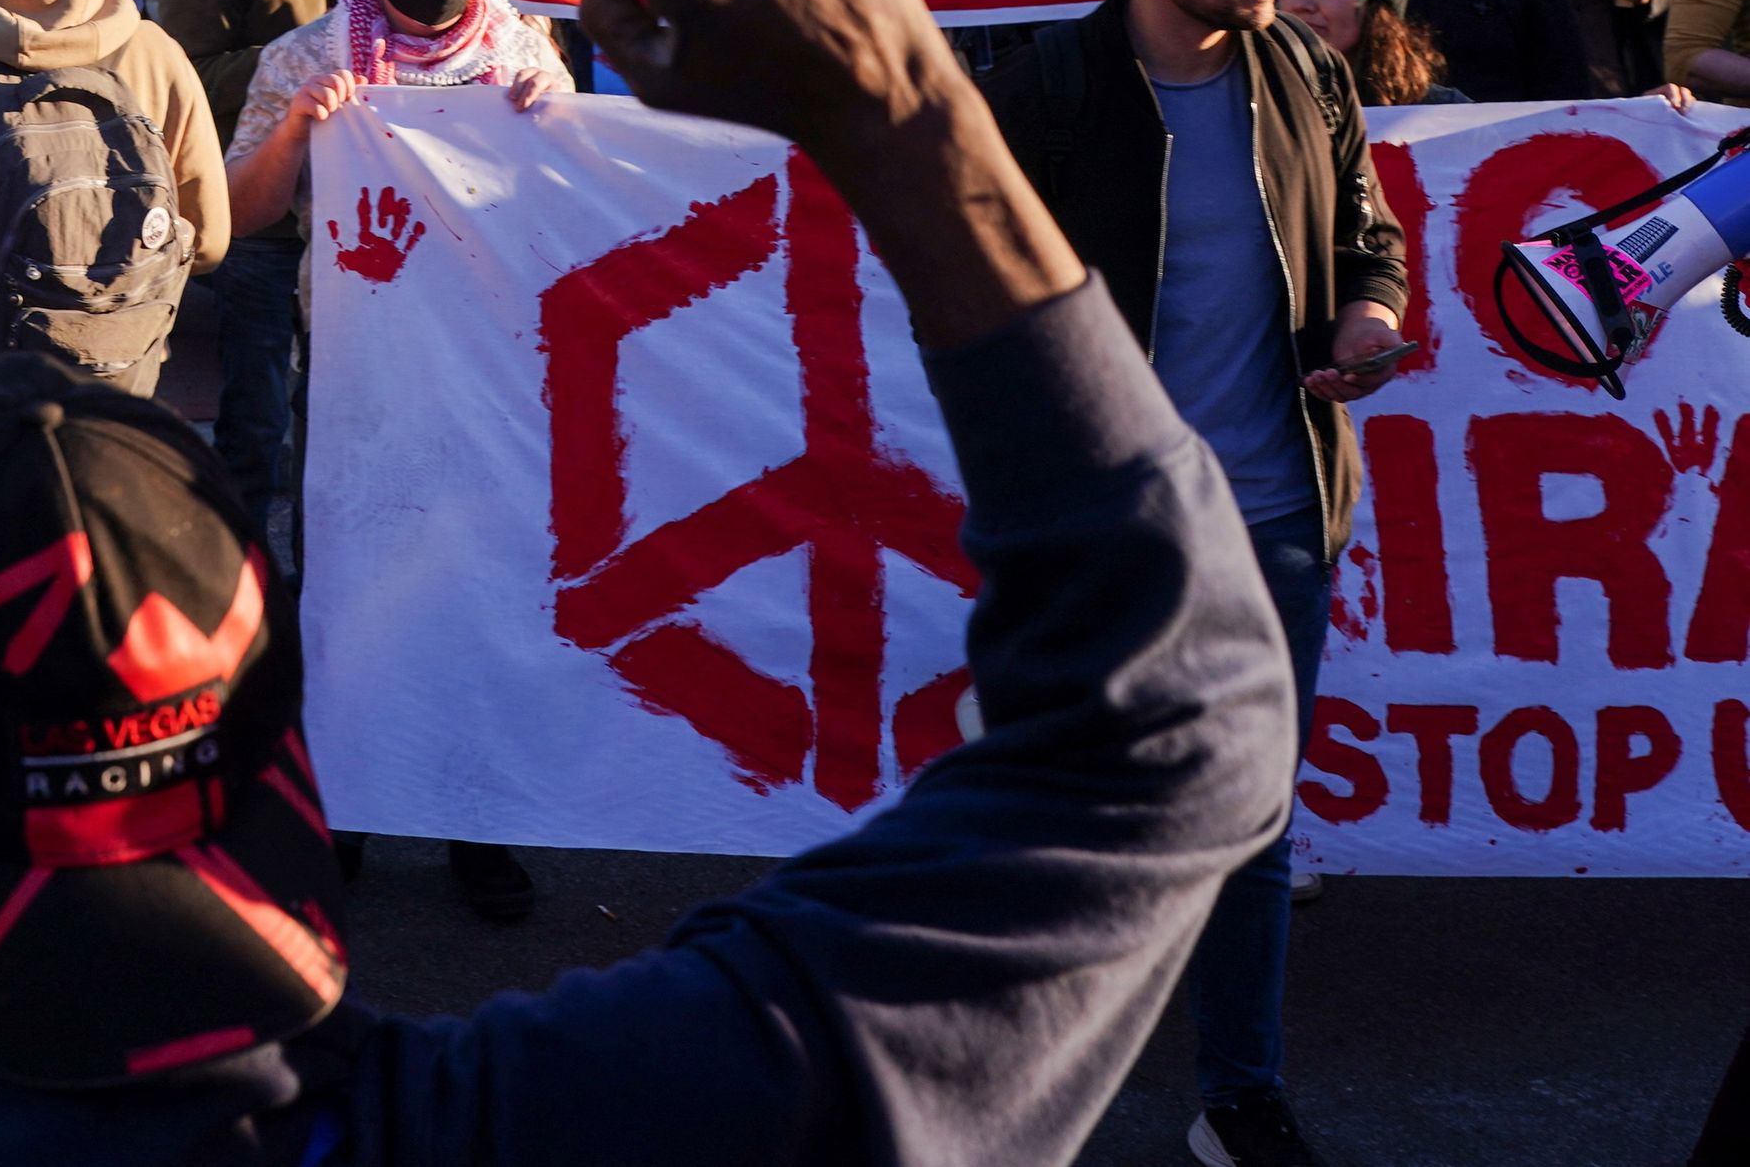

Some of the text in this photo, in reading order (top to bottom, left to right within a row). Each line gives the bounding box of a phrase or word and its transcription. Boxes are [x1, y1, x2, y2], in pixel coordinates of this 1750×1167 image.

[103, 689, 222, 750] VEGAS
[26, 738, 220, 799] RACING
[1296, 695, 1682, 832] STOP
